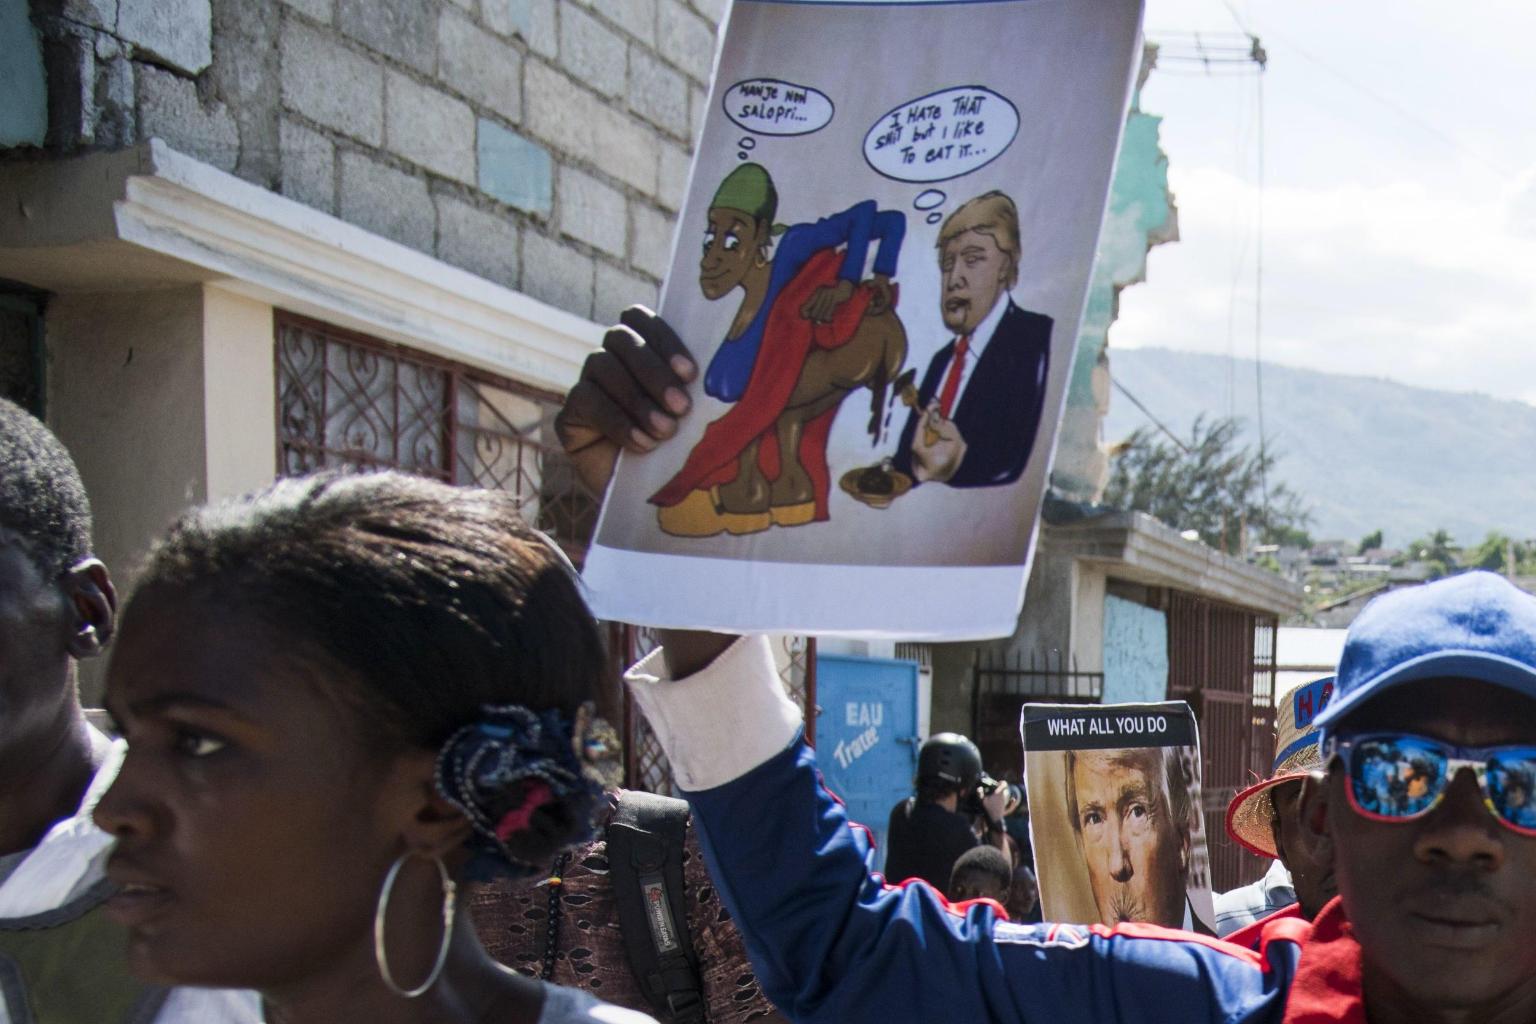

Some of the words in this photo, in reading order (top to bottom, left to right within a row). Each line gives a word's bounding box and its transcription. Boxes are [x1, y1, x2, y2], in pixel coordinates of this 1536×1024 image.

[889, 112, 901, 128] I
[952, 96, 987, 117] THAT
[846, 701, 884, 727] EAU
[1047, 718, 1086, 737] WHAT
[1089, 718, 1114, 735] ALL
[1115, 717, 1144, 734] YOU
[1147, 716, 1167, 733] DO
